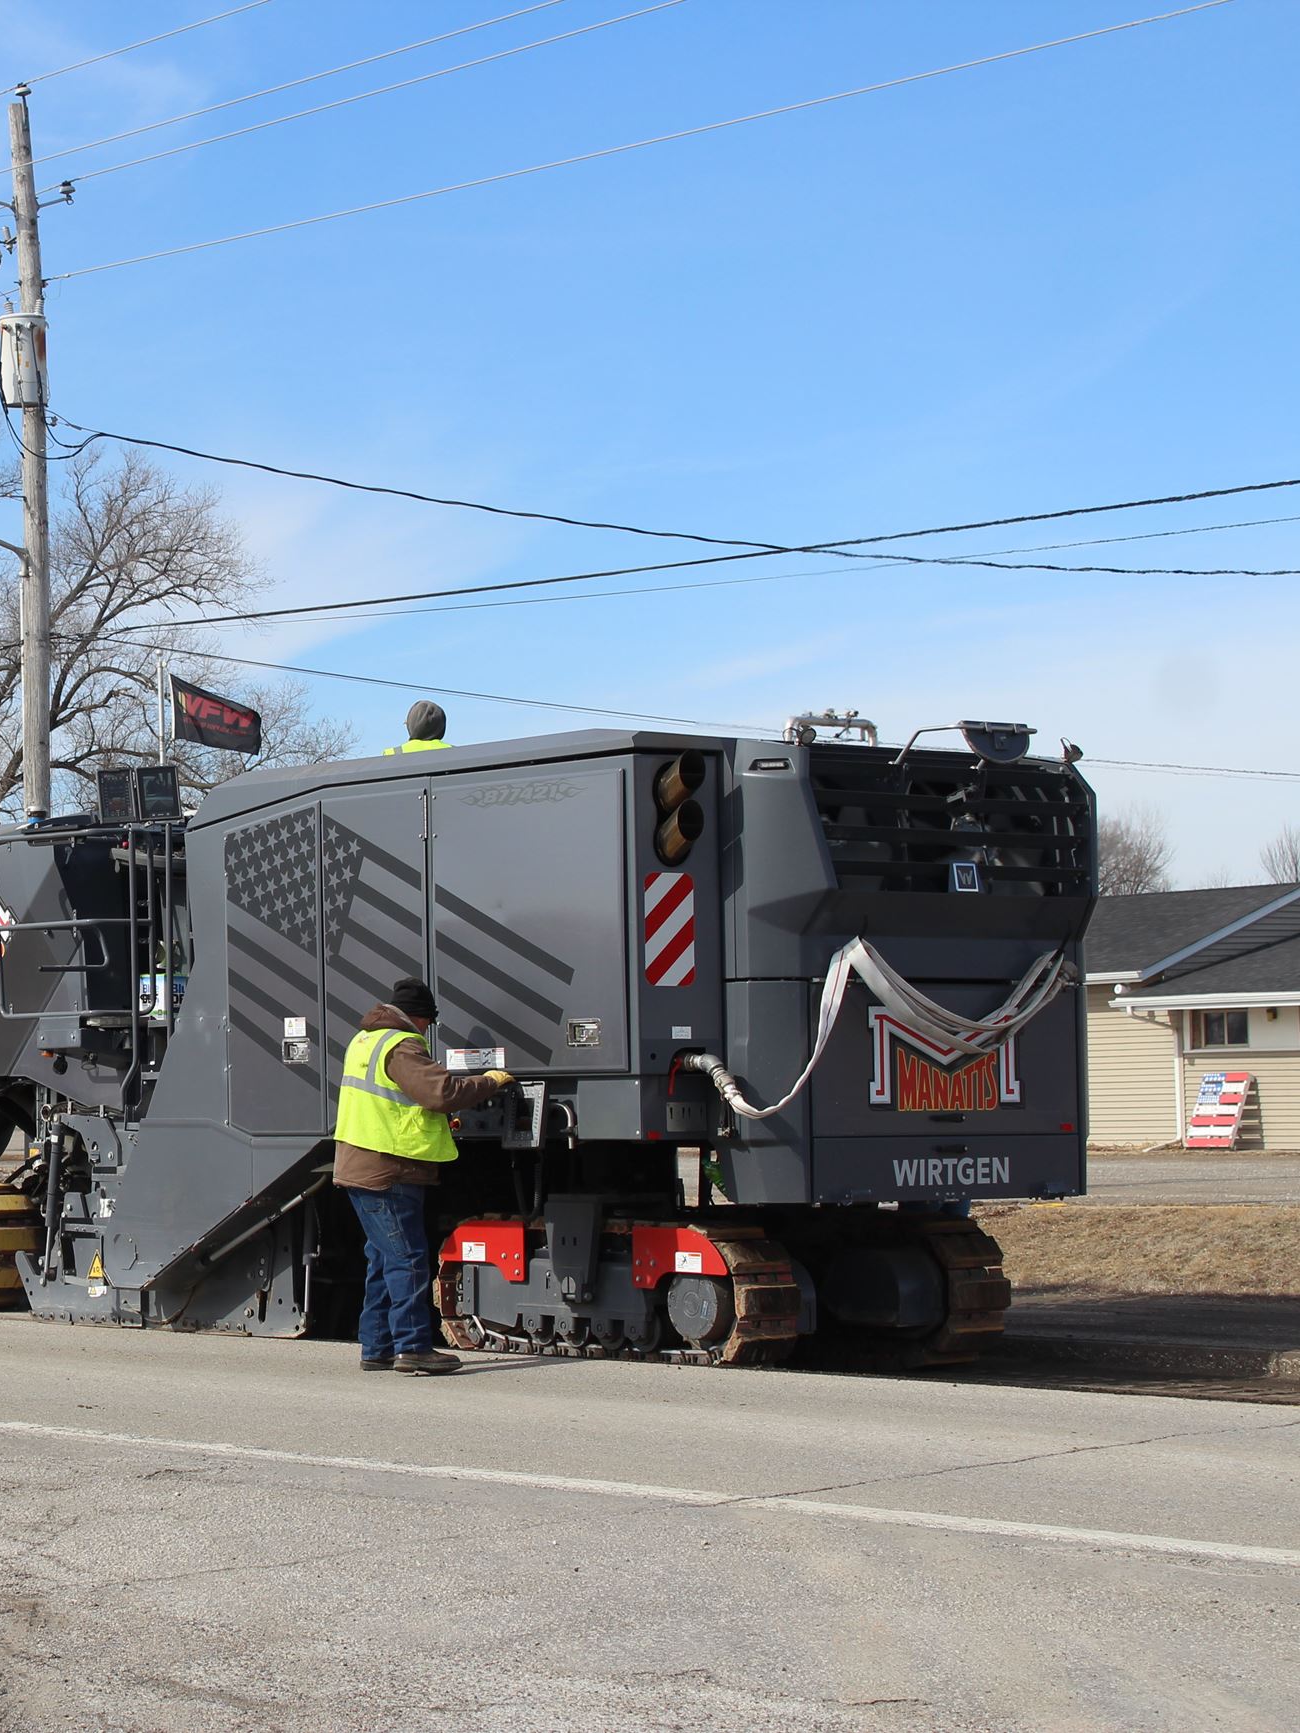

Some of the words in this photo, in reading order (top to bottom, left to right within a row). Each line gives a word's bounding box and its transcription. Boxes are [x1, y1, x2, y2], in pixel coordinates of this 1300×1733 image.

[185, 693, 254, 728] VFW
[897, 1047, 999, 1112] MANATTS
[893, 1156, 1010, 1187] WIRTGEN
